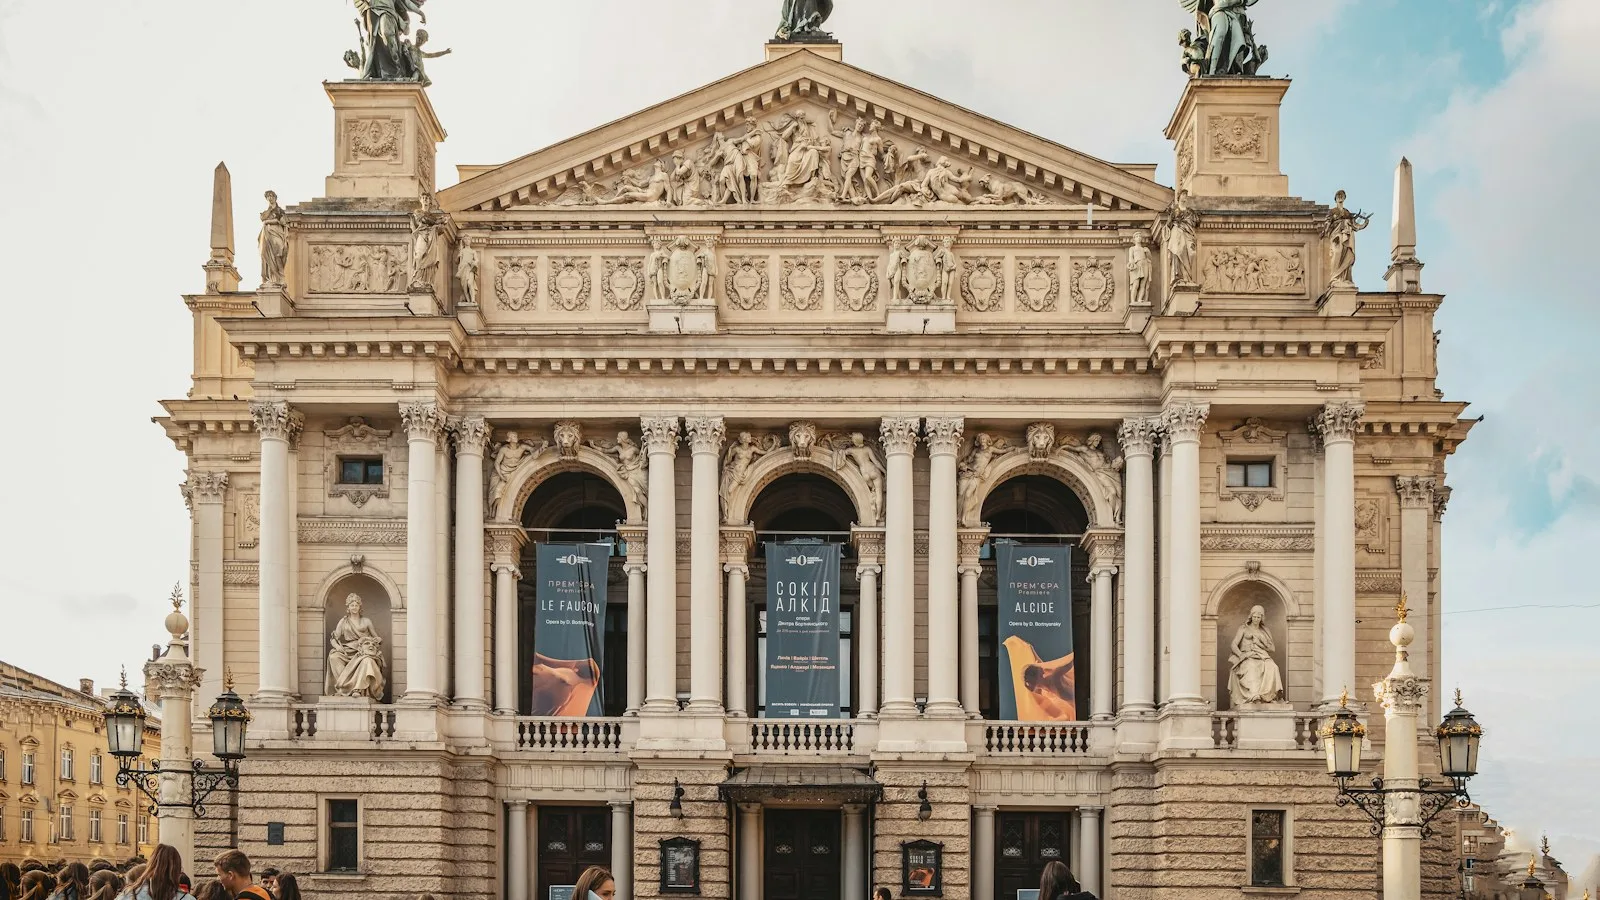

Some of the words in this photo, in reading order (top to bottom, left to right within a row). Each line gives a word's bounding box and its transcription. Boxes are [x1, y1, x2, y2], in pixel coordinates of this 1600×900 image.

[776, 580, 830, 596] СОКІЛ
[541, 600, 554, 611] LE
[560, 600, 600, 614] FAUCON
[776, 597, 830, 614] АЛКІД
[1015, 602, 1054, 614] ALCIDE
